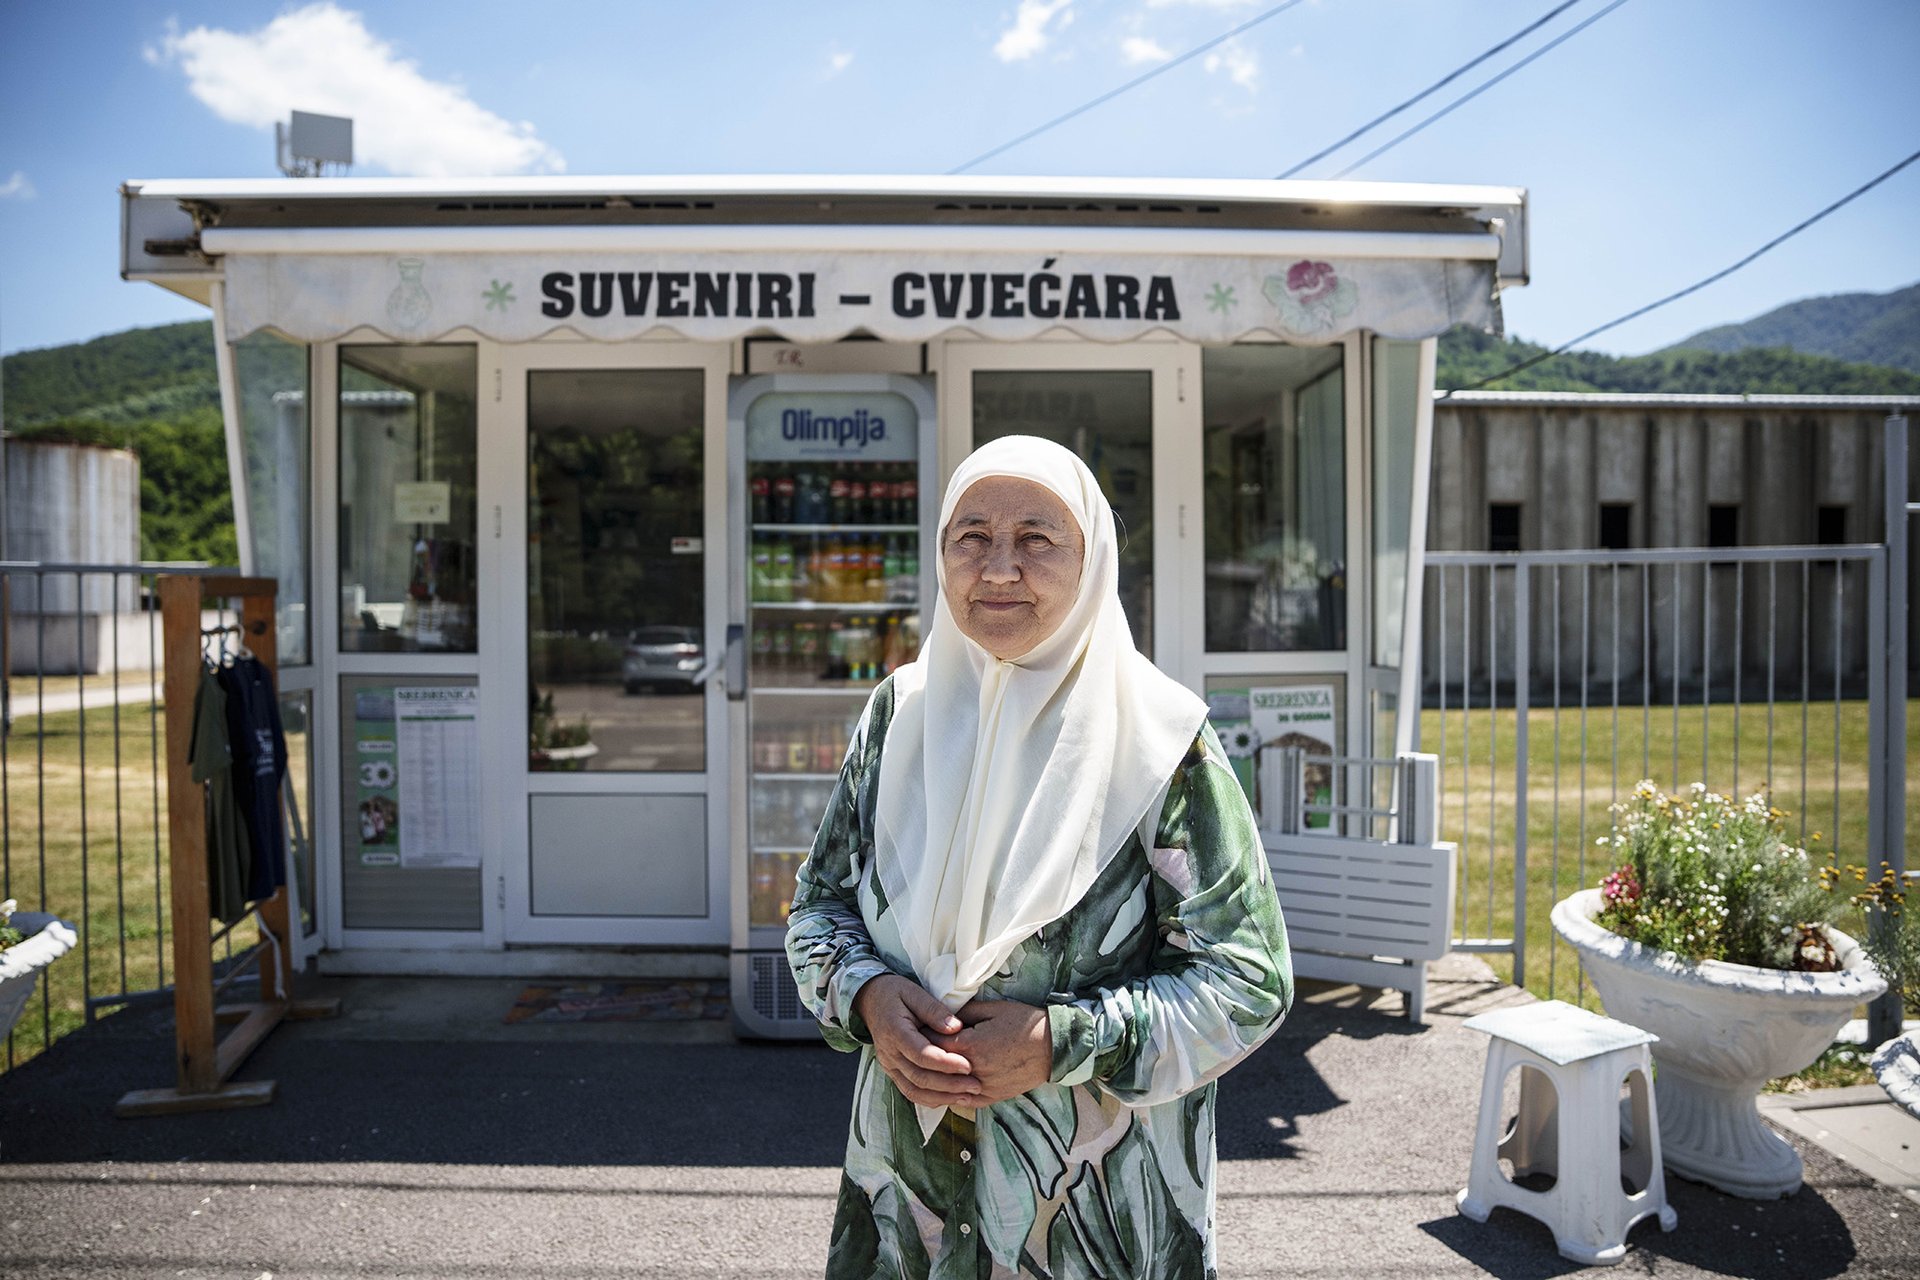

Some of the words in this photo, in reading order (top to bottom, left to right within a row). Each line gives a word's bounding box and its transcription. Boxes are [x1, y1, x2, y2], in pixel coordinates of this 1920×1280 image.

[541, 271, 816, 319] SUVENIRI
[892, 258, 1182, 321] CVJEĆARA
[782, 408, 886, 448] Olimpija
[360, 760, 397, 788] 30
